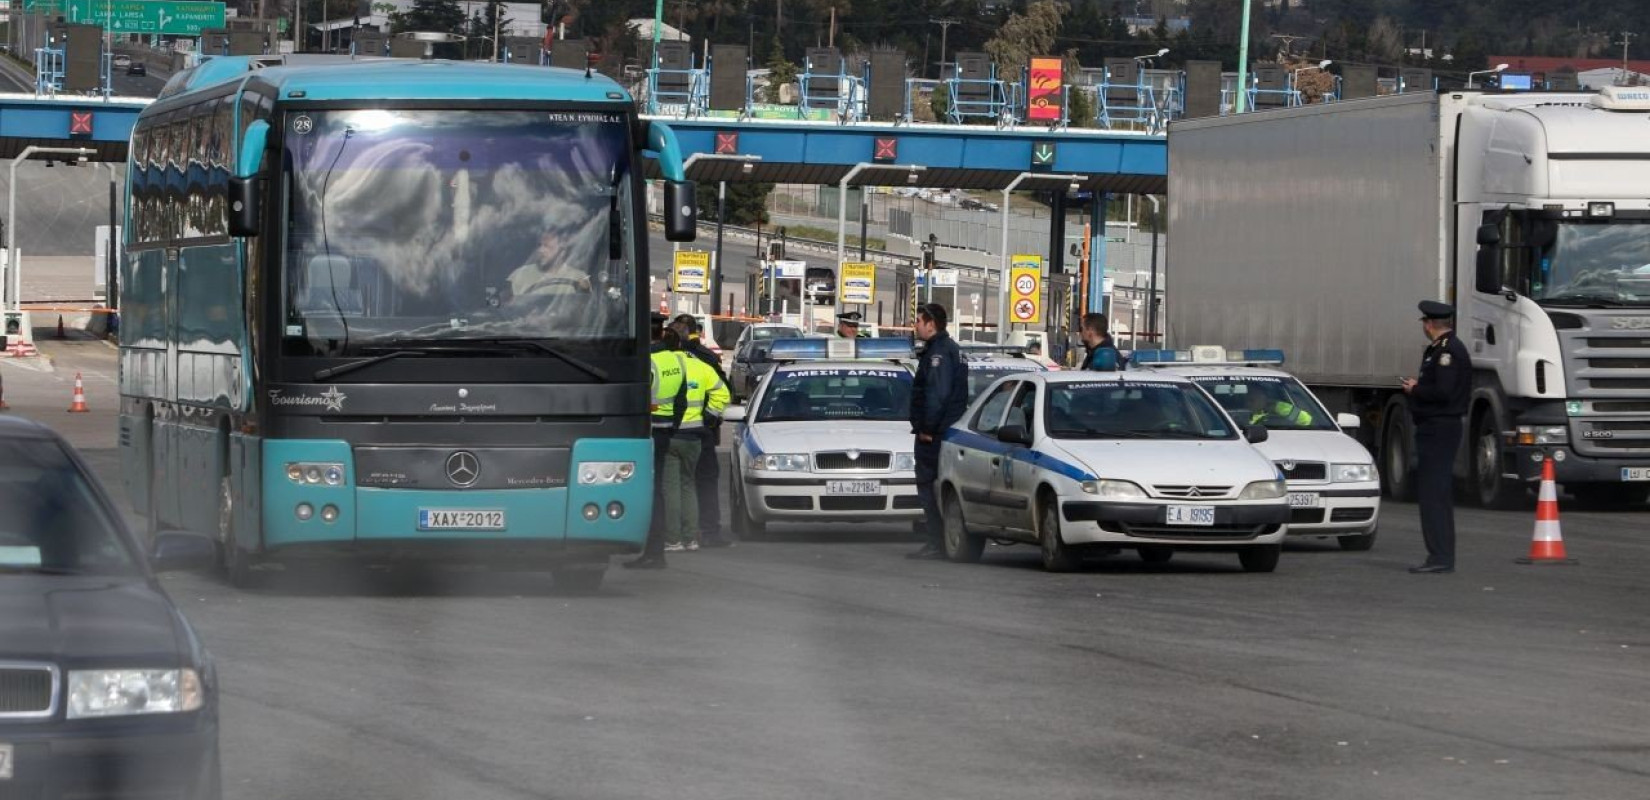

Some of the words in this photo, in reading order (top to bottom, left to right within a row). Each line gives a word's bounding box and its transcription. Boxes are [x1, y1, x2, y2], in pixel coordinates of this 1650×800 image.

[295, 120, 310, 129] 28
[1019, 280, 1032, 289] 20
[661, 367, 681, 378] POLICE
[787, 370, 839, 378] ΑΜΕΣΗ
[847, 370, 898, 378] ΔΡΑΣΗ
[267, 389, 331, 406] Tourismo
